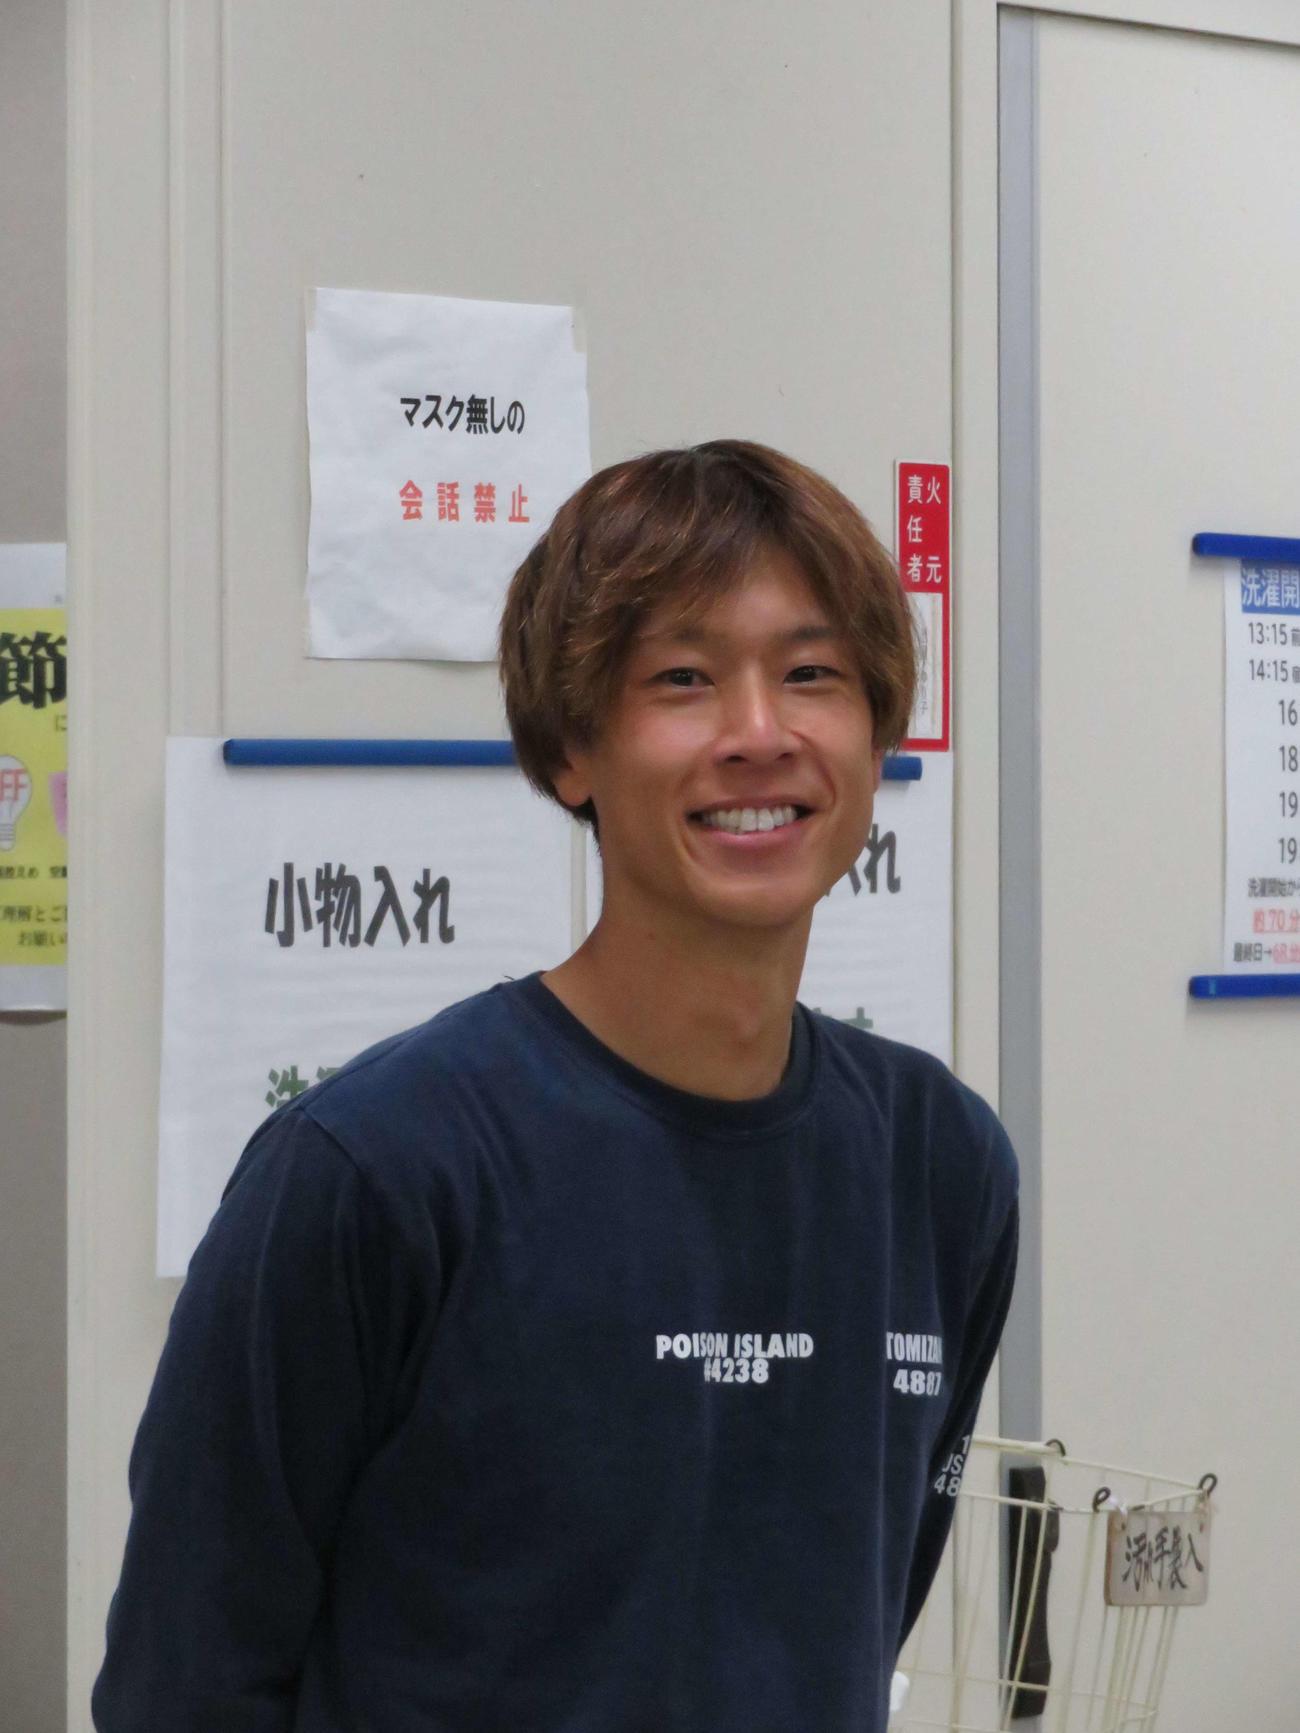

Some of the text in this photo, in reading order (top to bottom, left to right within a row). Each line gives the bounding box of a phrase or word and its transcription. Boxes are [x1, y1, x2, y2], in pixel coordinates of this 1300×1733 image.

[400, 394, 525, 434] マスク無しの
[399, 480, 530, 523] 会話禁止
[907, 474, 923, 583] 責任者
[1248, 622, 1288, 645] 13:15
[1249, 660, 1289, 683] 14:15
[265, 862, 455, 948] 小物入れ
[656, 1332, 814, 1359] POISON ISLAND
[703, 1357, 769, 1384] #4238
[893, 1368, 942, 1396] 4887
